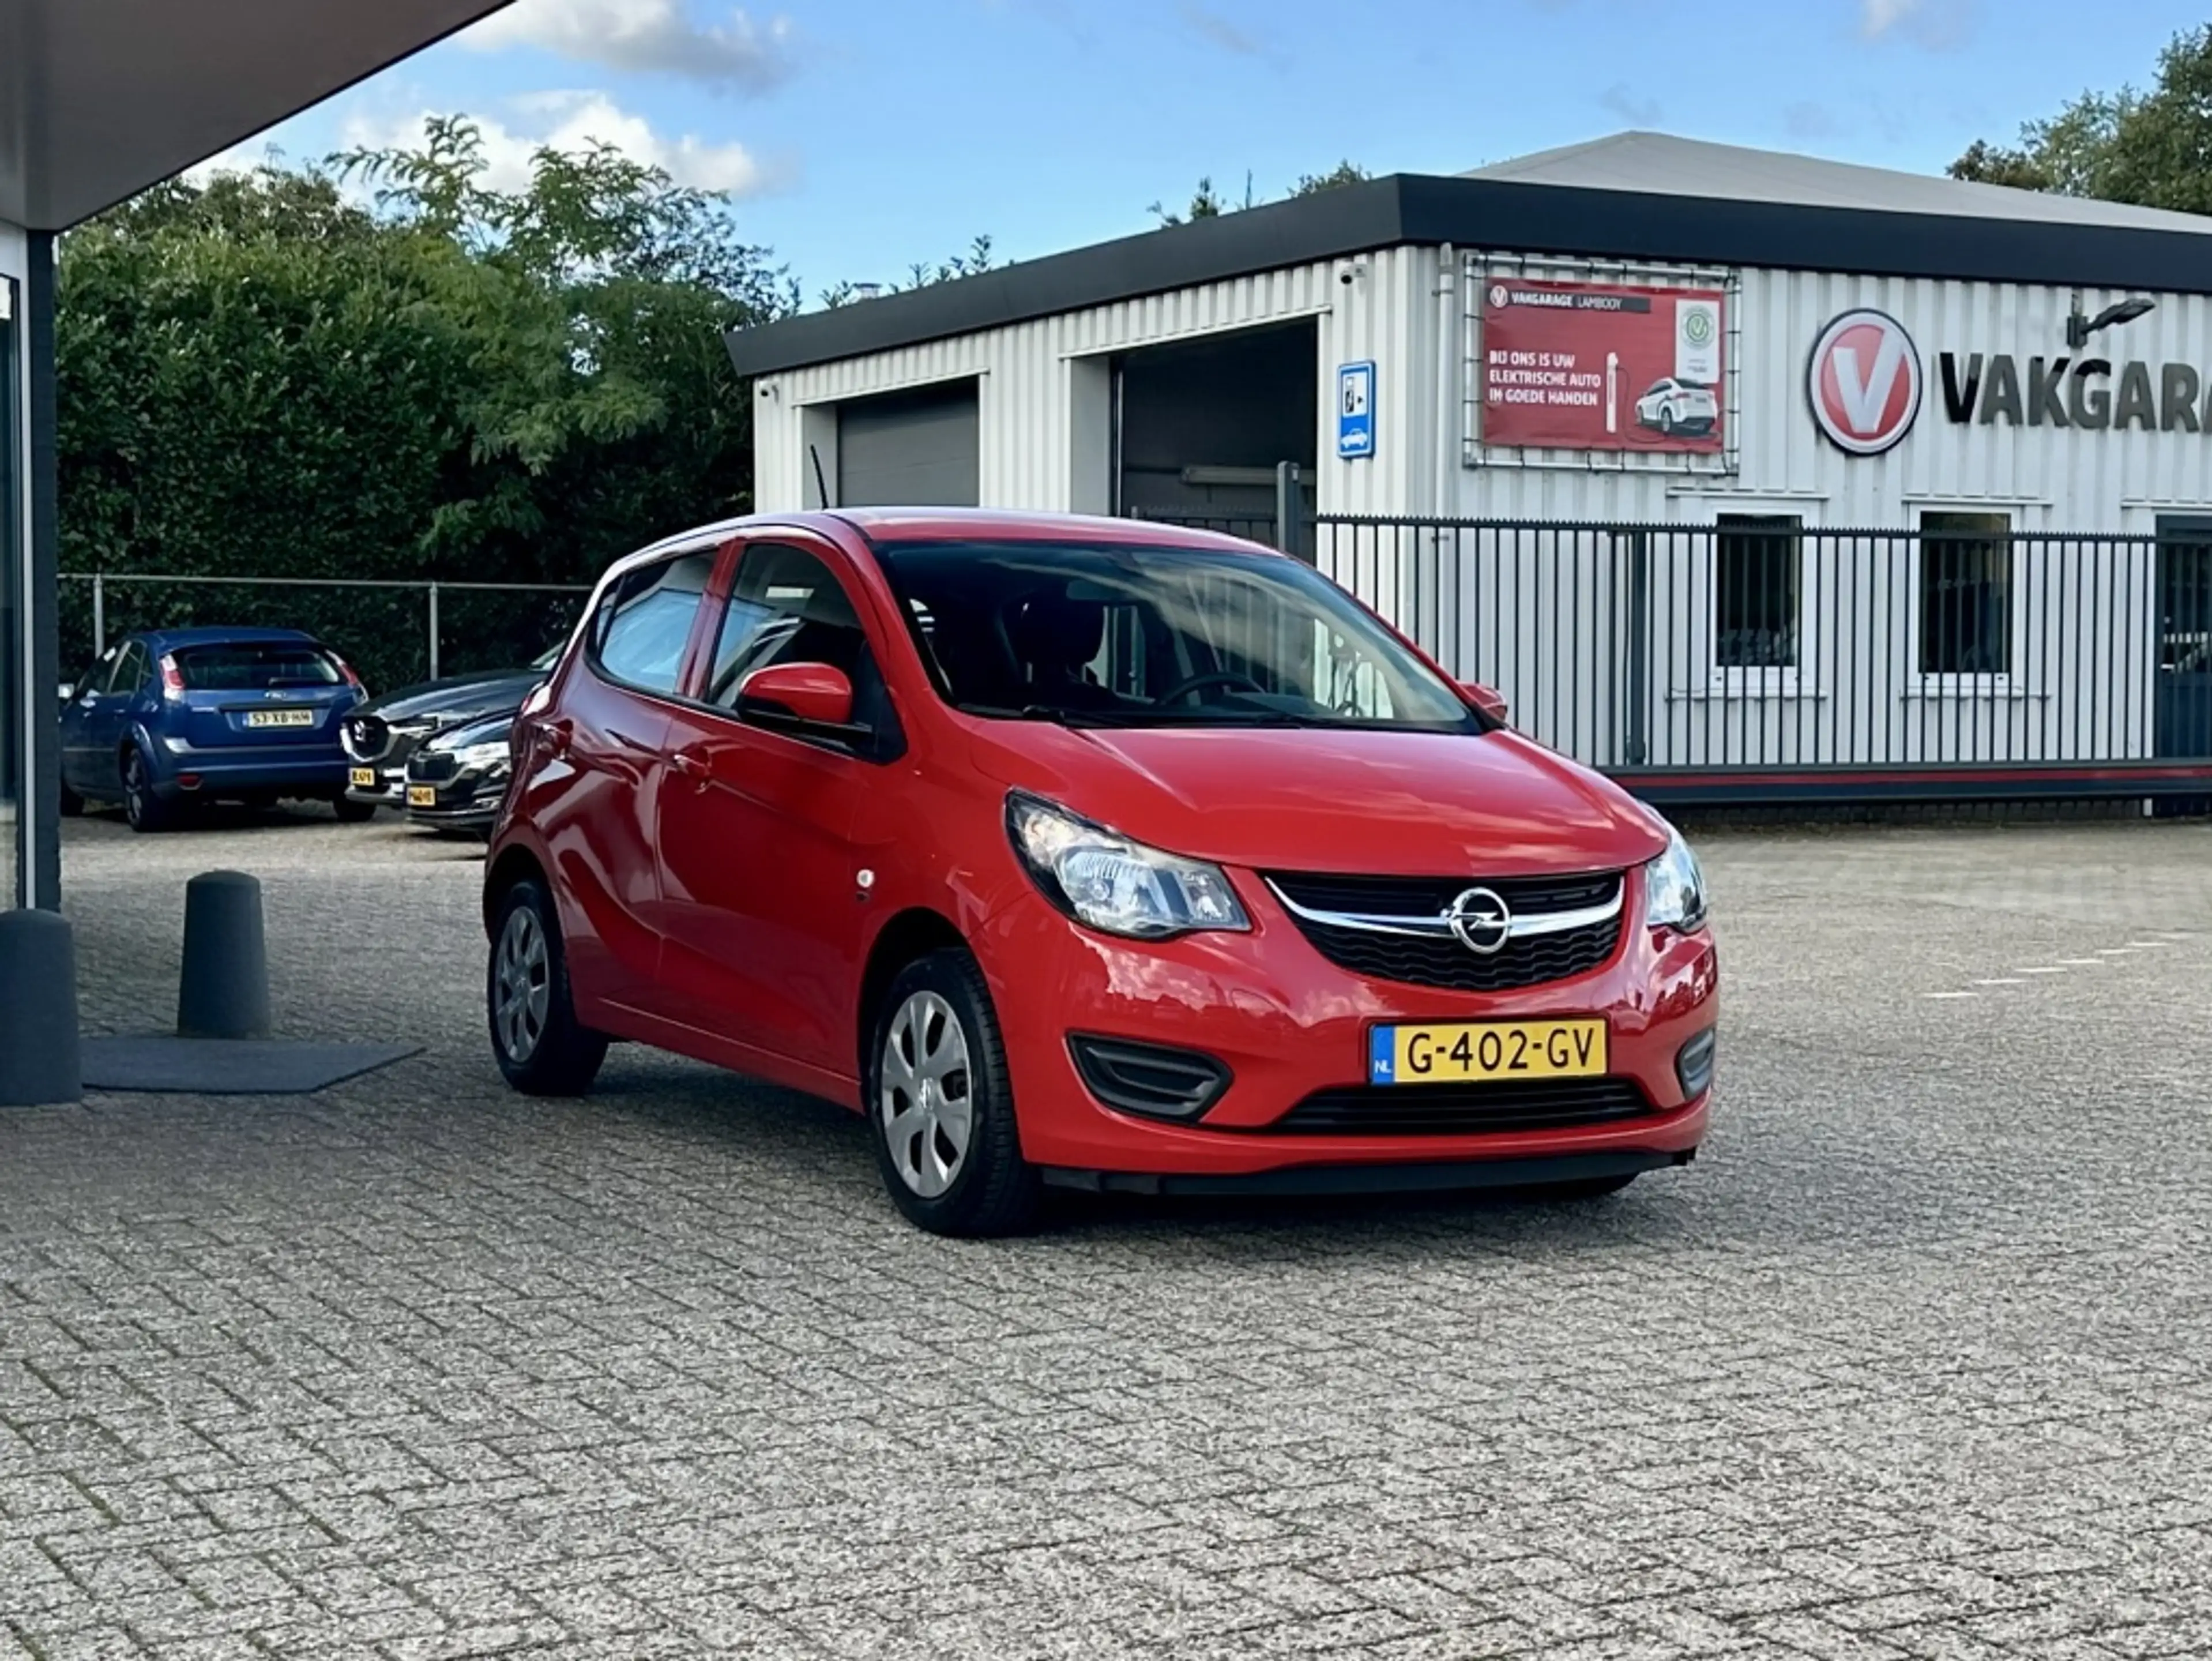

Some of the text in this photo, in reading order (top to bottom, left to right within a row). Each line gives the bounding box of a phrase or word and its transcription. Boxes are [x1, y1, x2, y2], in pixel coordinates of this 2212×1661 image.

[1511, 291, 1573, 307] VAKGARAGE
[1489, 350, 1575, 369] BIJ ONS IS UW
[1489, 369, 1601, 388] ELEKTRISCHE AUTO
[1489, 387, 1598, 406] IN GOEDE HANDEN
[1940, 352, 2212, 433] VAKGAR
[1408, 1028, 1594, 1074] G-402-GV
[1375, 1059, 1392, 1073] NL
